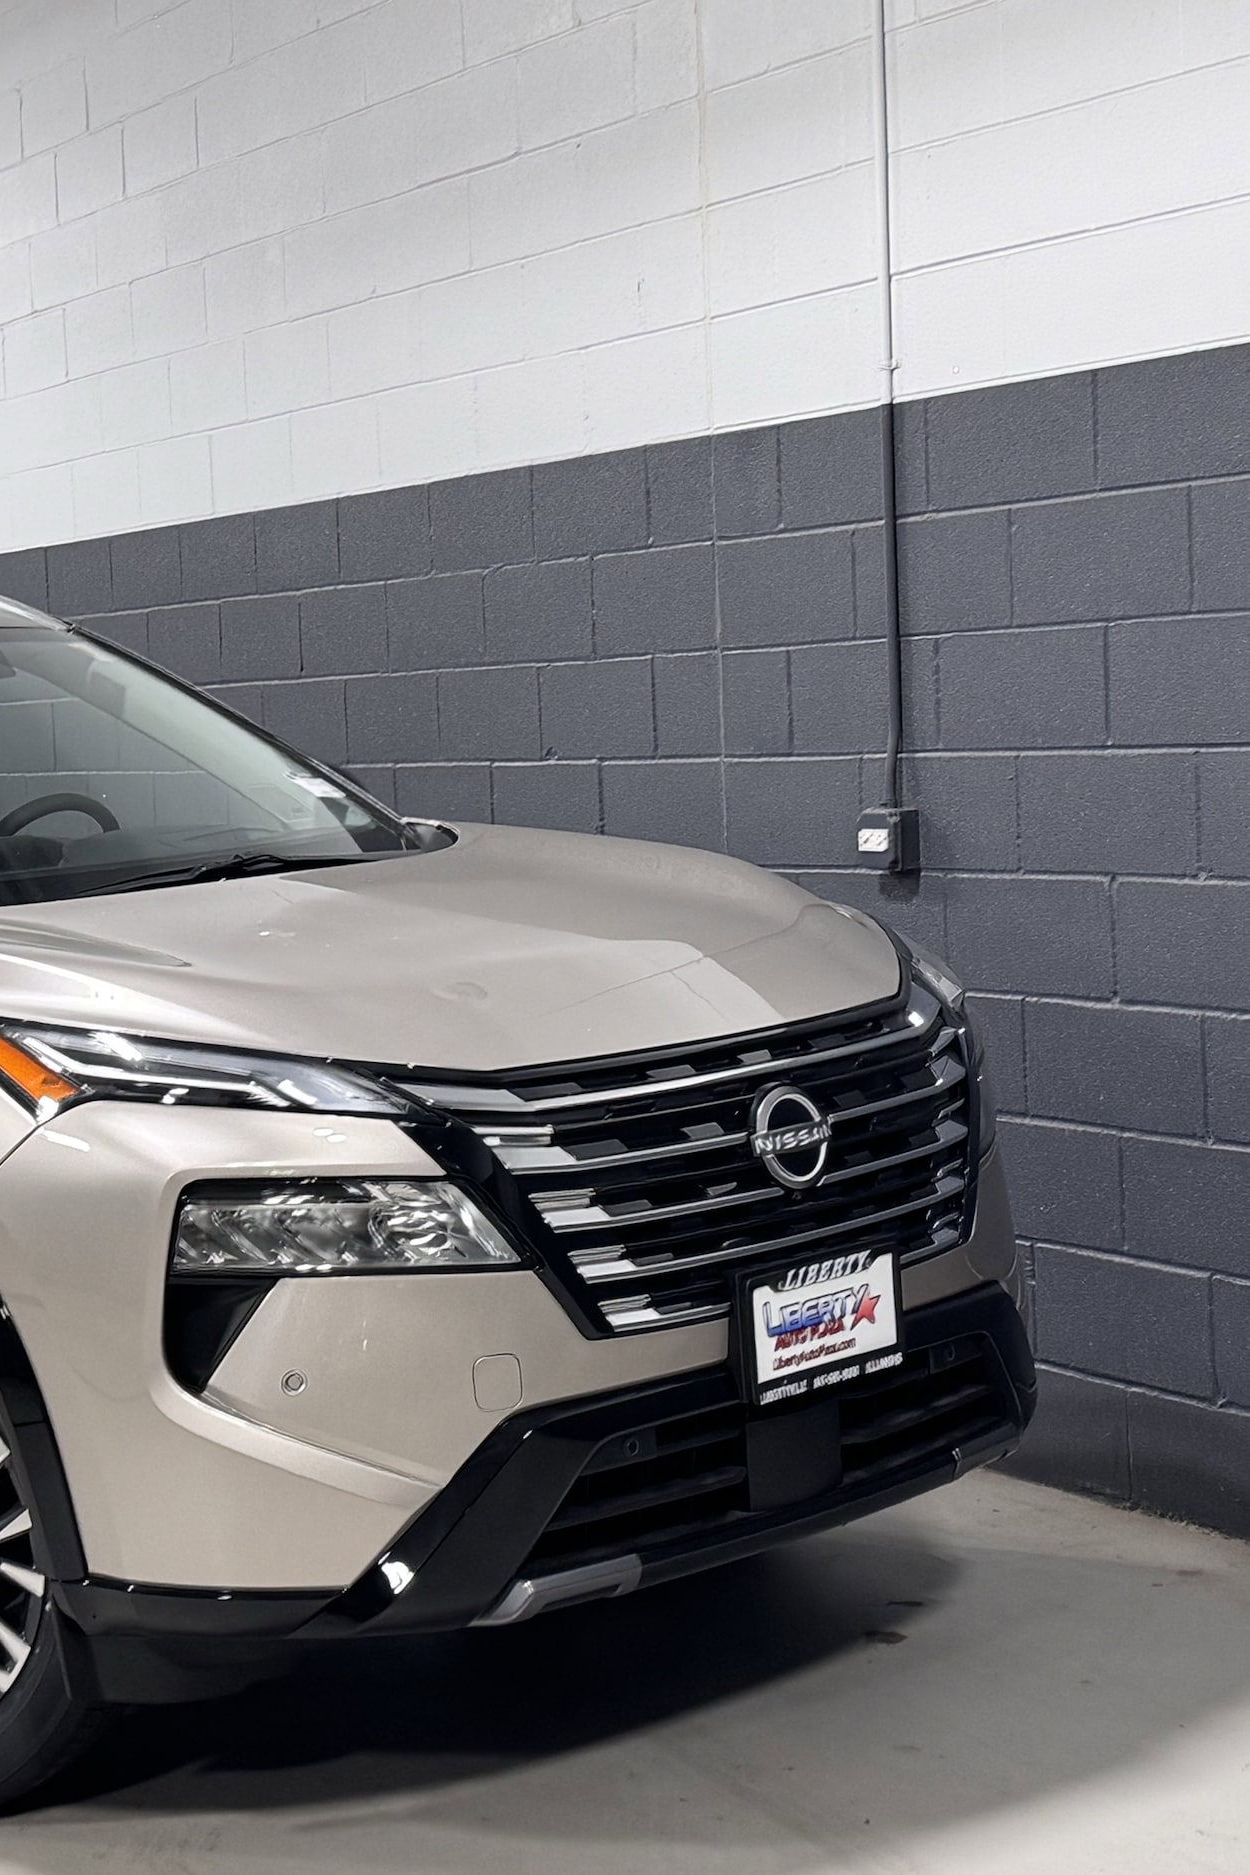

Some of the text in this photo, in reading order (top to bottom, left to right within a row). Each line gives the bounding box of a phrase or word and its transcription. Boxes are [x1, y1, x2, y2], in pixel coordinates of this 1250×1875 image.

[754, 1123, 832, 1154] NISSAN
[781, 1250, 871, 1290] LIBERTY
[762, 1283, 869, 1338] LIBERTY
